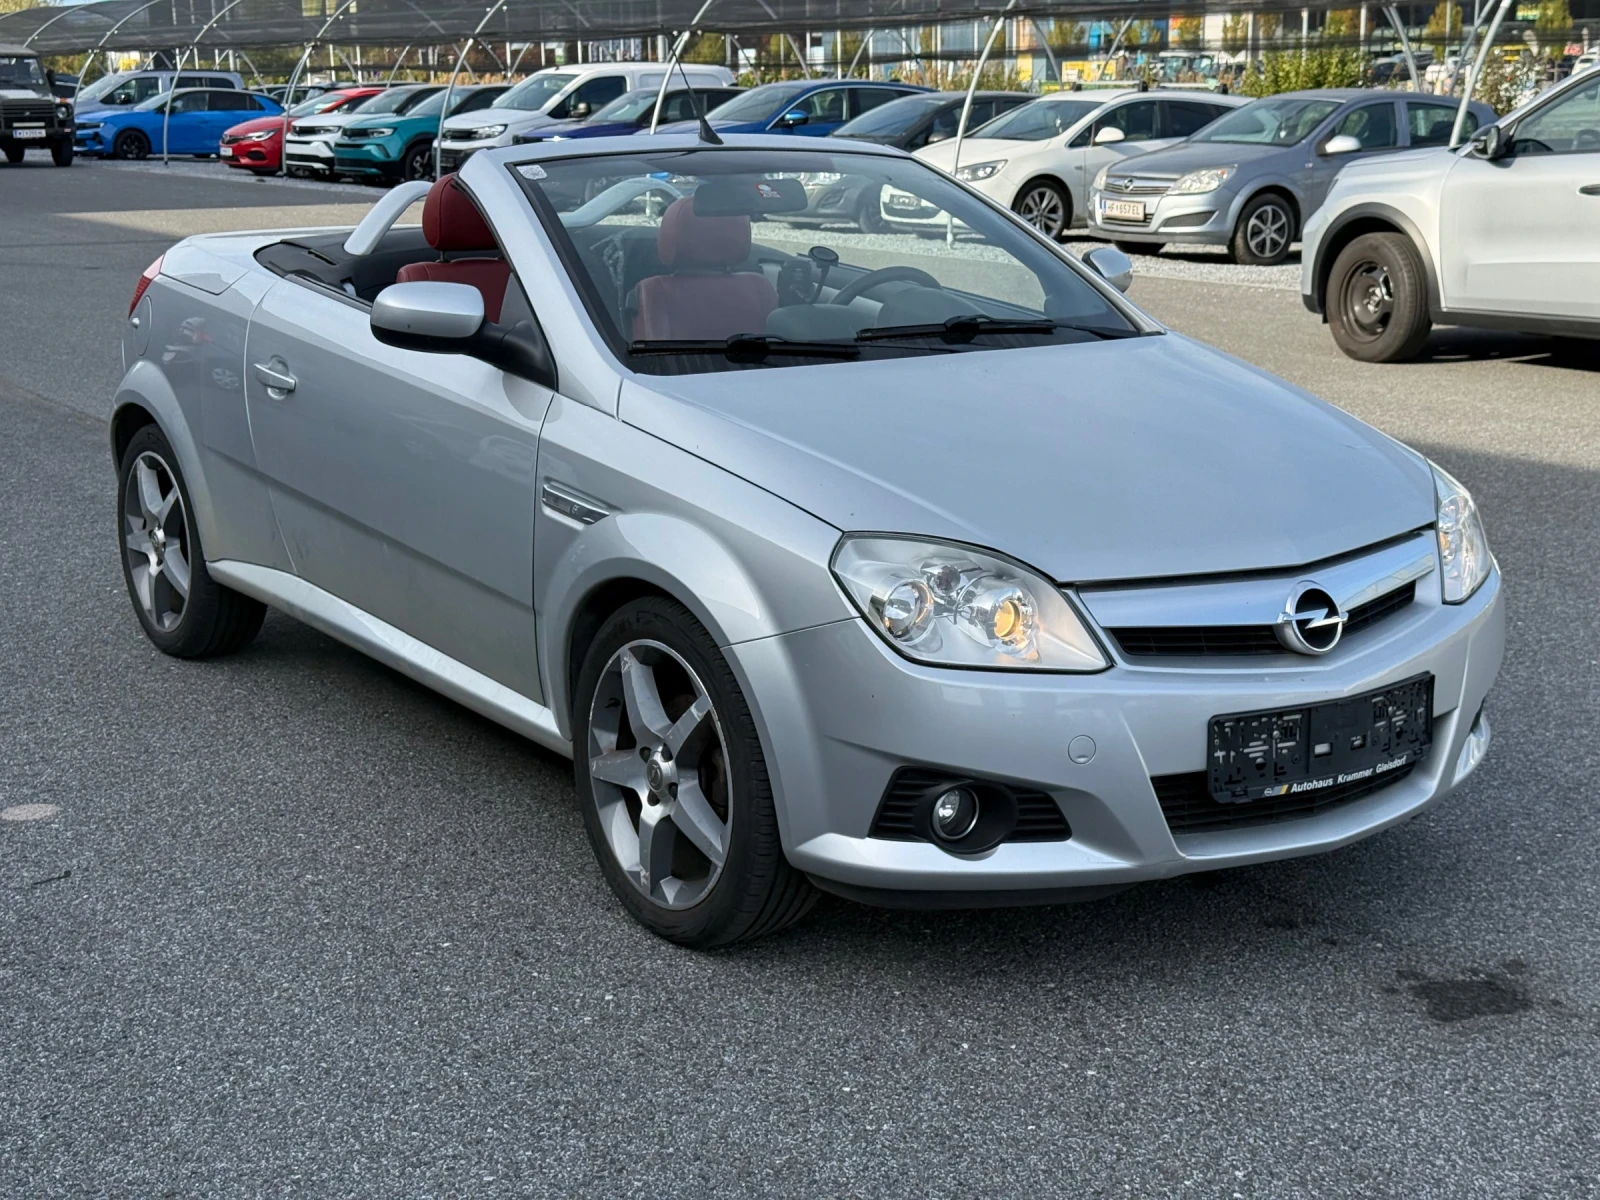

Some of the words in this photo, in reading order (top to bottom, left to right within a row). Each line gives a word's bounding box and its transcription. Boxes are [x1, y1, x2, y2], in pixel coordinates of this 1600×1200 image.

[1290, 777, 1333, 794] Autohaus
[1337, 767, 1374, 784] Krammer
[1376, 754, 1407, 774] Gleisdorf
